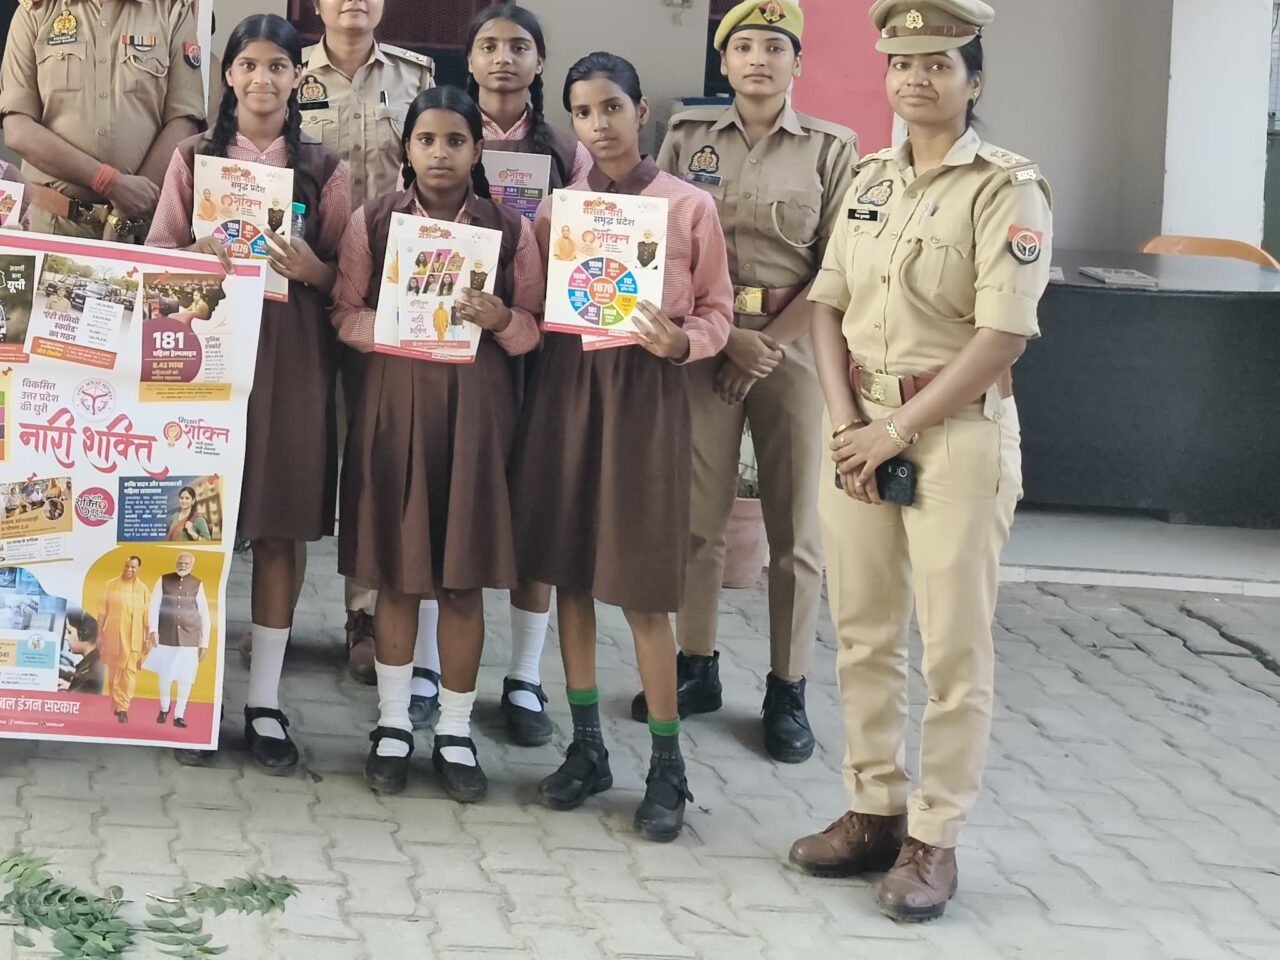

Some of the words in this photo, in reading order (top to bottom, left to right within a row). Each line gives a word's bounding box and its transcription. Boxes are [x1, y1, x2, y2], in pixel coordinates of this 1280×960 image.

[7, 279, 26, 293] यूपी
[153, 331, 184, 349] 181
[22, 378, 56, 391] विकसित
[21, 390, 37, 401] उत्तर
[38, 391, 59, 404] प्रदेश
[20, 402, 32, 413] की
[33, 402, 48, 416] धुरी
[18, 407, 77, 469] नारी
[82, 413, 170, 480] शक्ति
[17, 696, 42, 712] इंजन
[44, 700, 81, 714] सरकार
